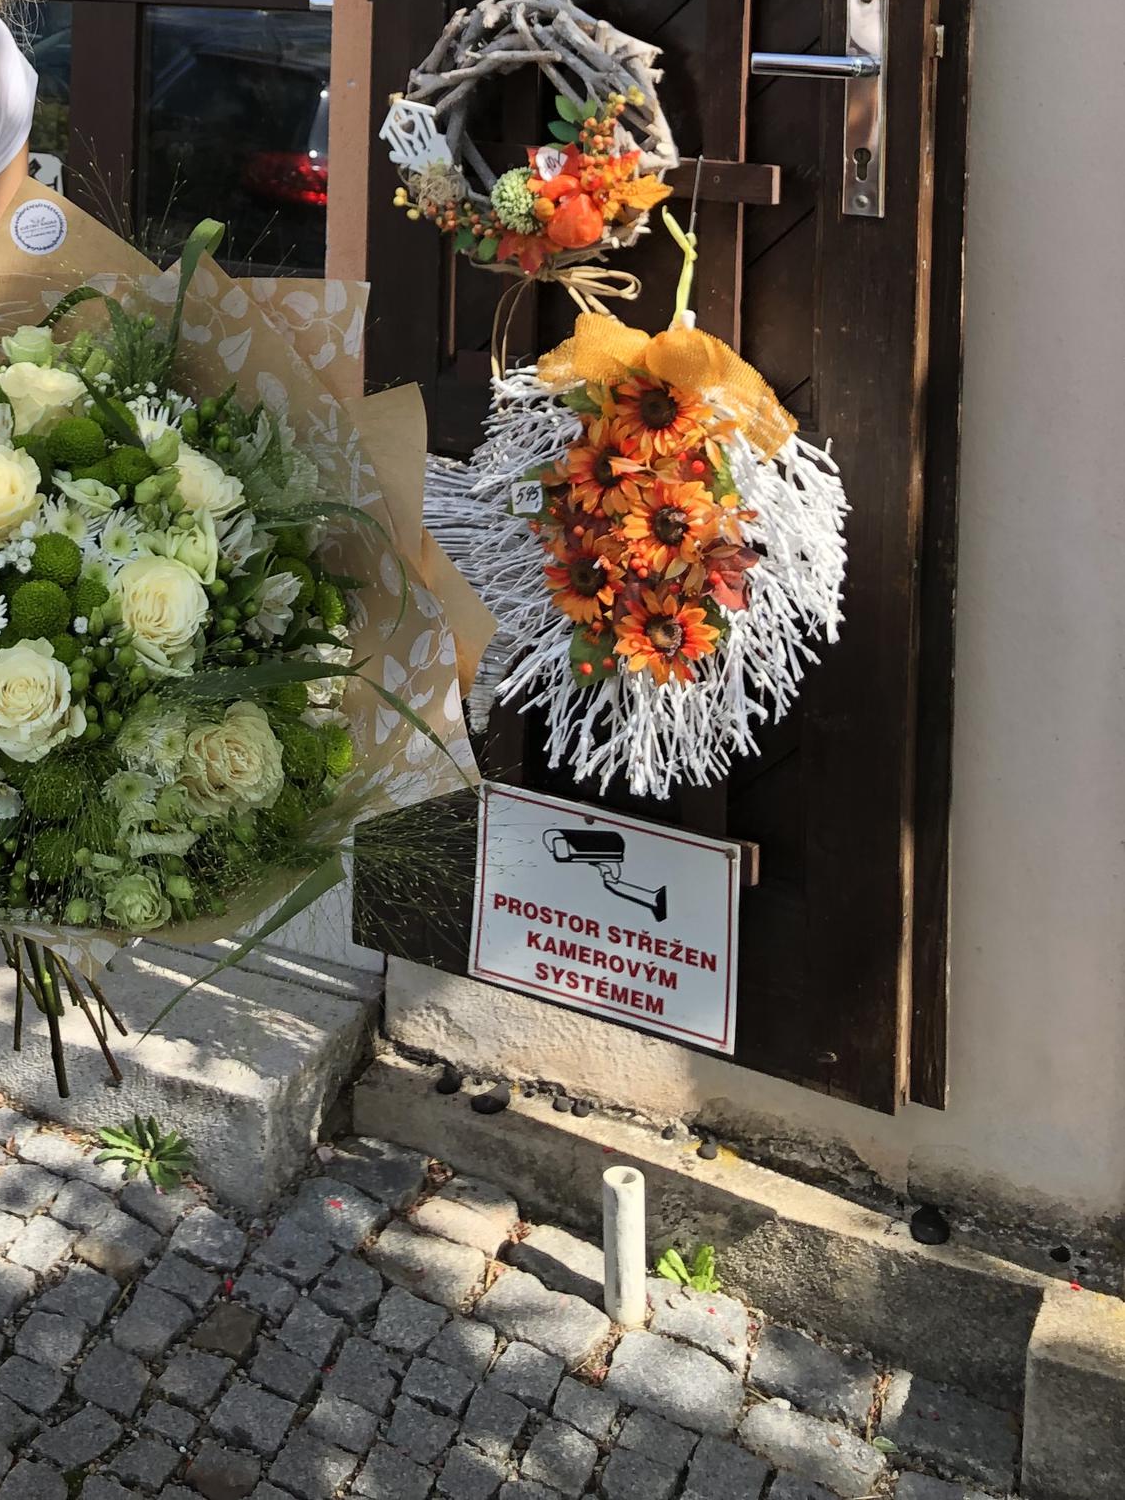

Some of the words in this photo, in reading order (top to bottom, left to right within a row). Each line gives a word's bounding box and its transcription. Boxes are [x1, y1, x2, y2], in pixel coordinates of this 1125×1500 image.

[493, 893, 601, 938] PROSTOR
[607, 924, 718, 973] STŘEŽEN
[526, 931, 678, 990] KAMEROVÝM
[534, 962, 665, 1015] SYSTÉMEM
